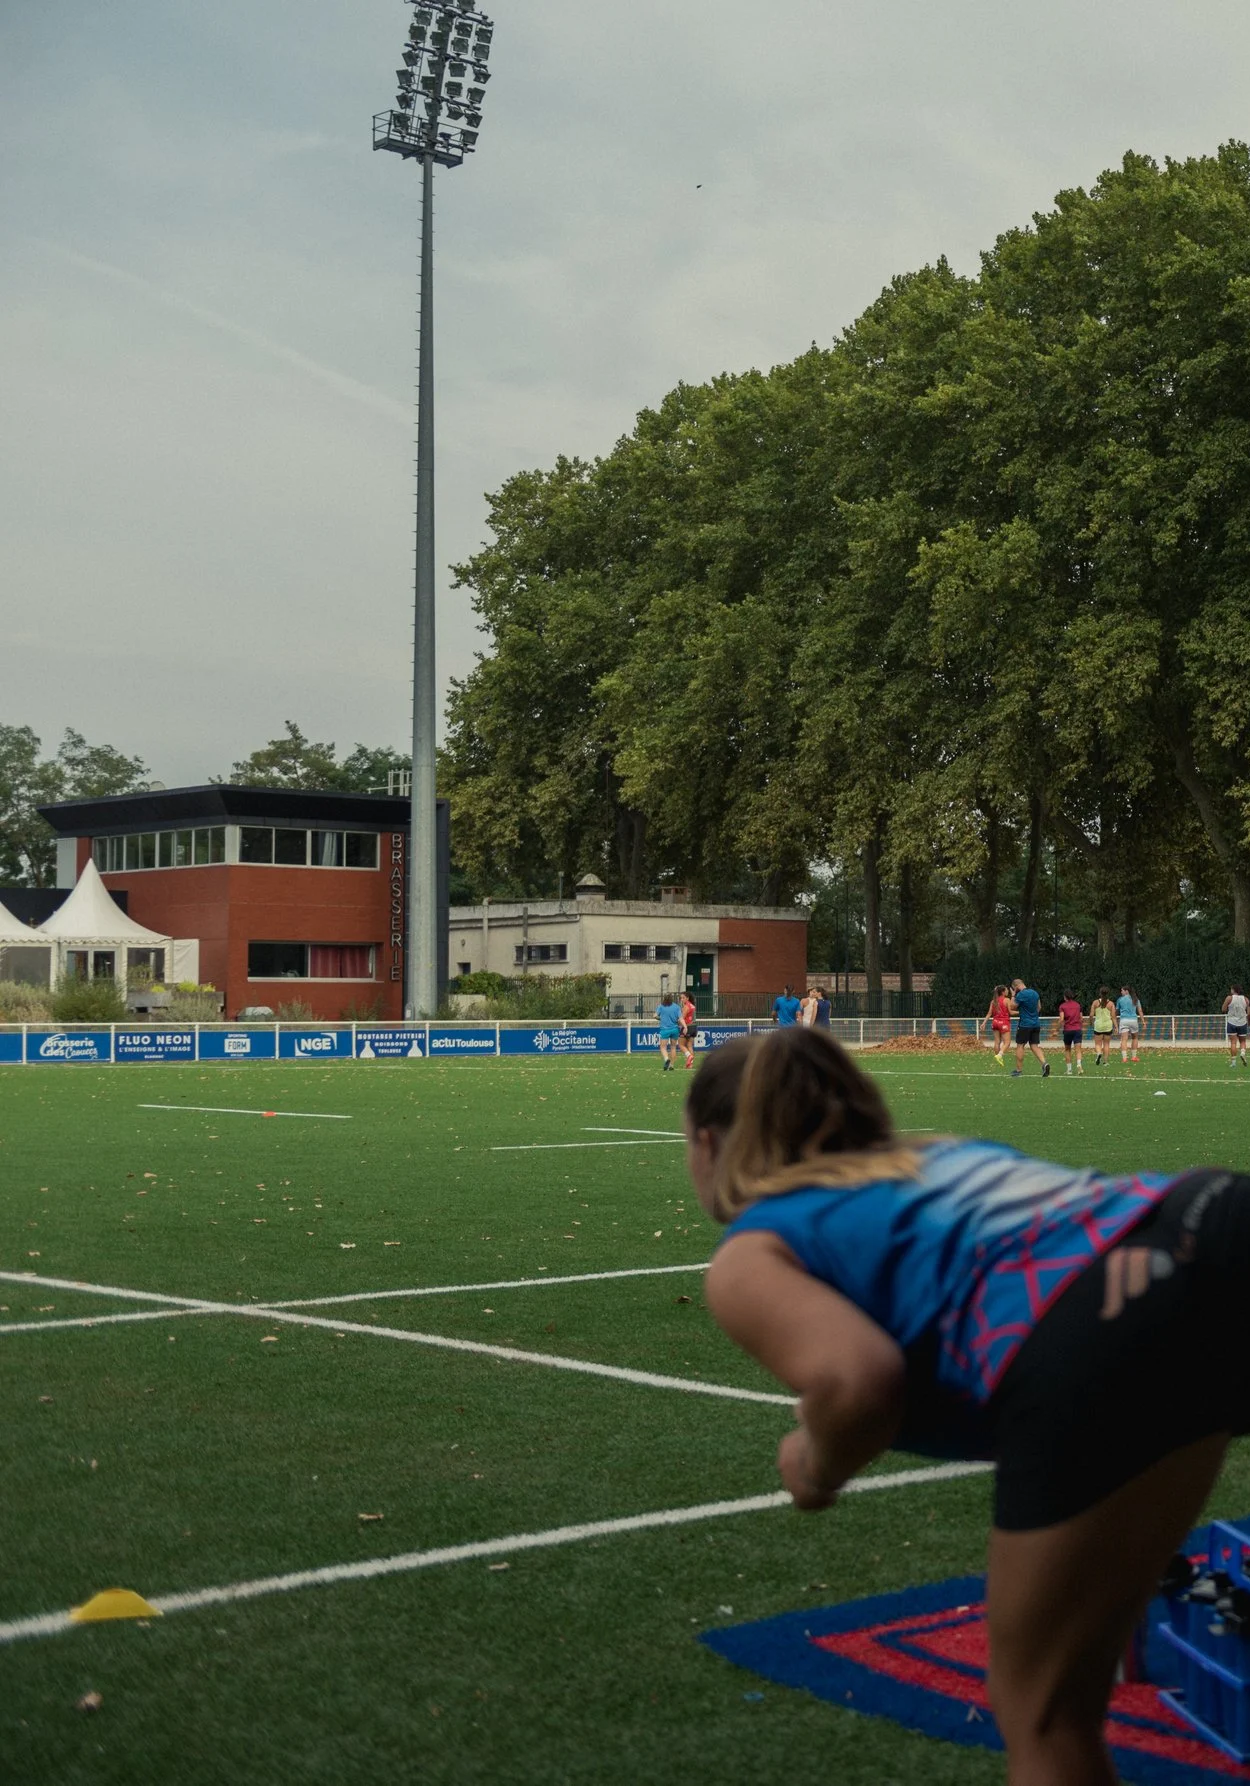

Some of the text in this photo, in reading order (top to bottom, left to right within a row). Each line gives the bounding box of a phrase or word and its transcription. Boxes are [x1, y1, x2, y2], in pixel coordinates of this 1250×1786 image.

[391, 833, 402, 981] BRASSERIE
[46, 1036, 95, 1047] Brasserie
[119, 1035, 192, 1045] FLUO NEON
[228, 1040, 247, 1050] FORM
[300, 1037, 332, 1050] NGE
[552, 1035, 597, 1046] Occitanie
